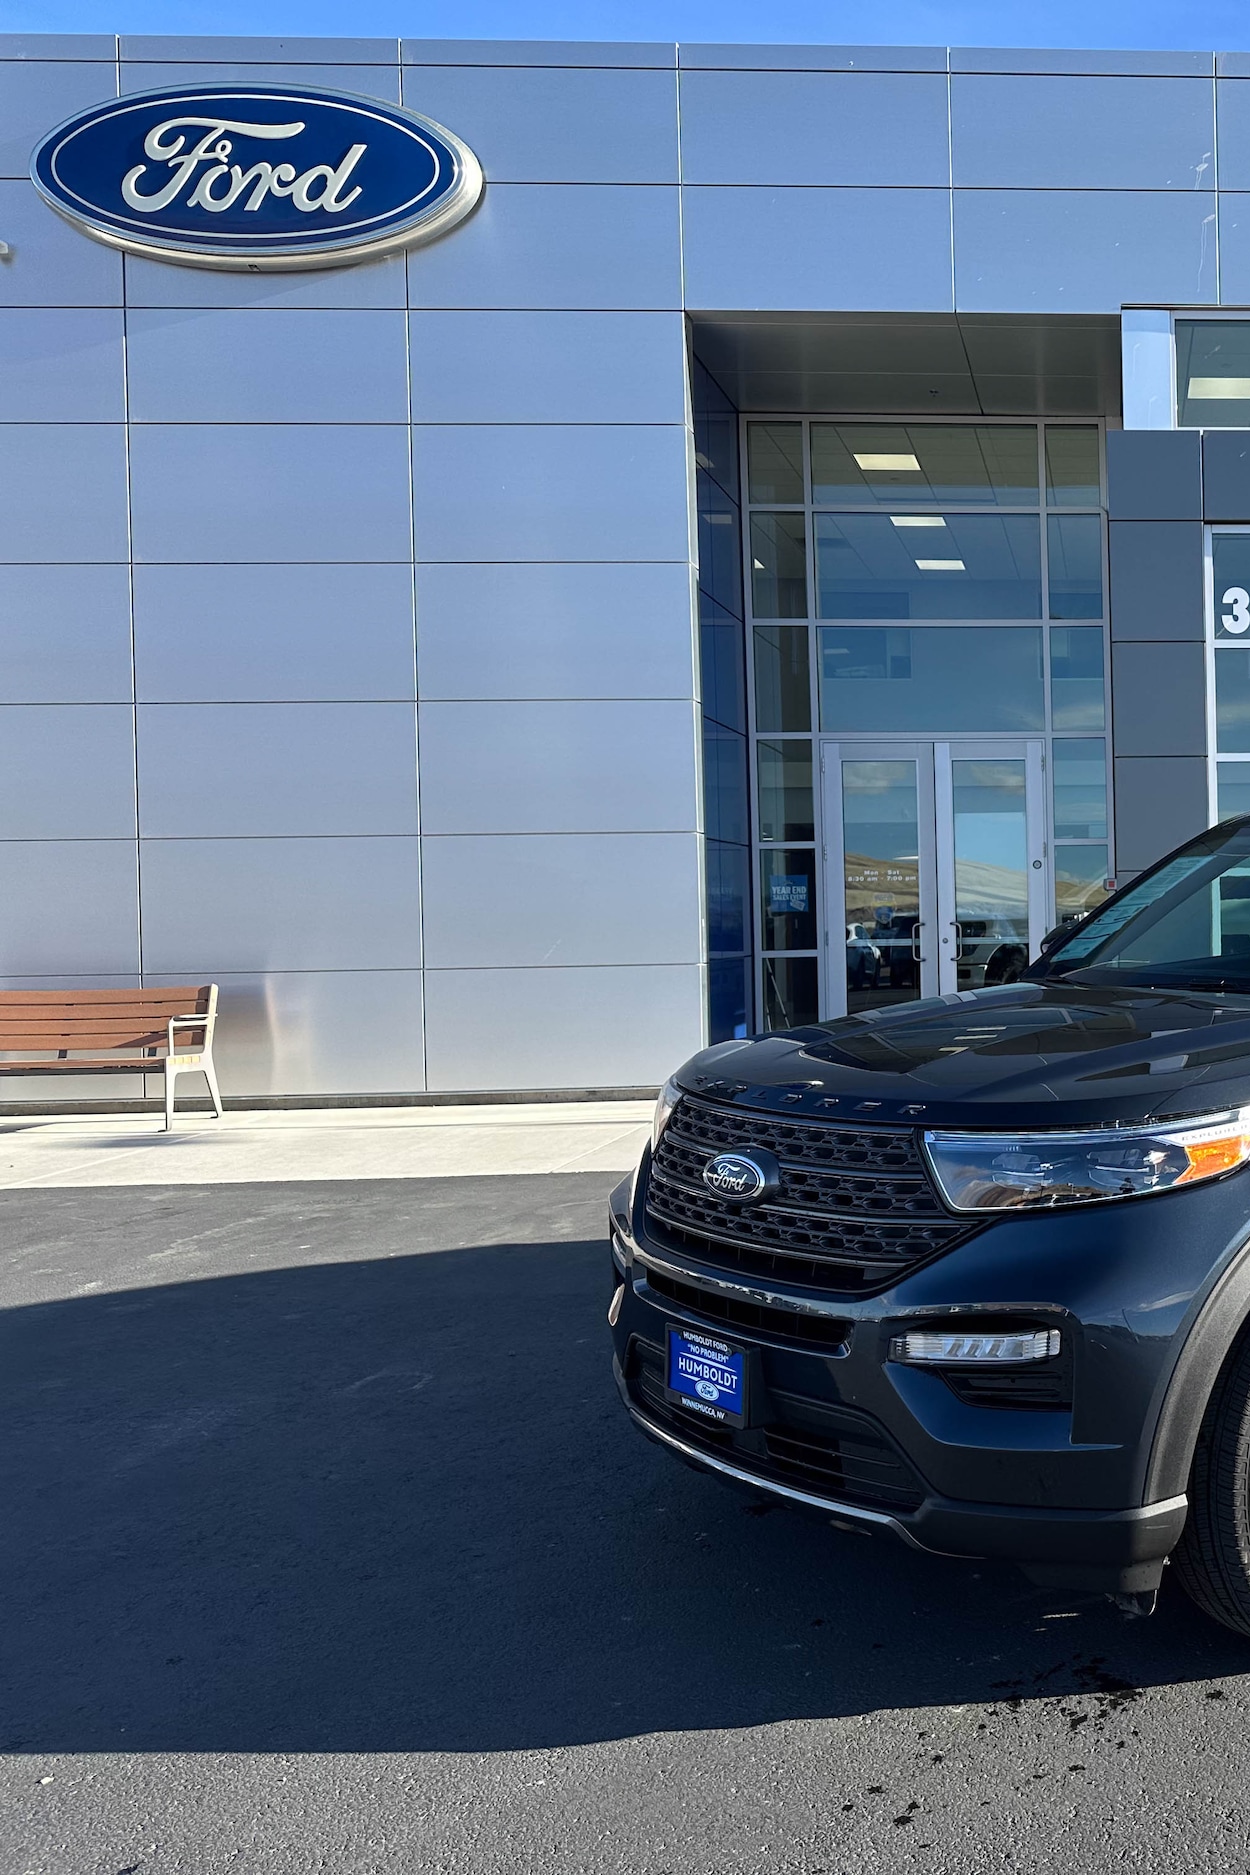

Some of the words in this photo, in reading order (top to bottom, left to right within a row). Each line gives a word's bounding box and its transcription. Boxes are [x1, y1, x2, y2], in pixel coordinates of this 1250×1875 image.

[121, 116, 368, 213] Ford
[771, 886, 791, 895] YEAR
[792, 886, 807, 894] END
[712, 1162, 747, 1192] Ford
[683, 1331, 712, 1347] HUMBOLDT
[712, 1340, 728, 1352] FORD
[678, 1357, 738, 1389] HUMBOLDT
[716, 1410, 725, 1420] NV
